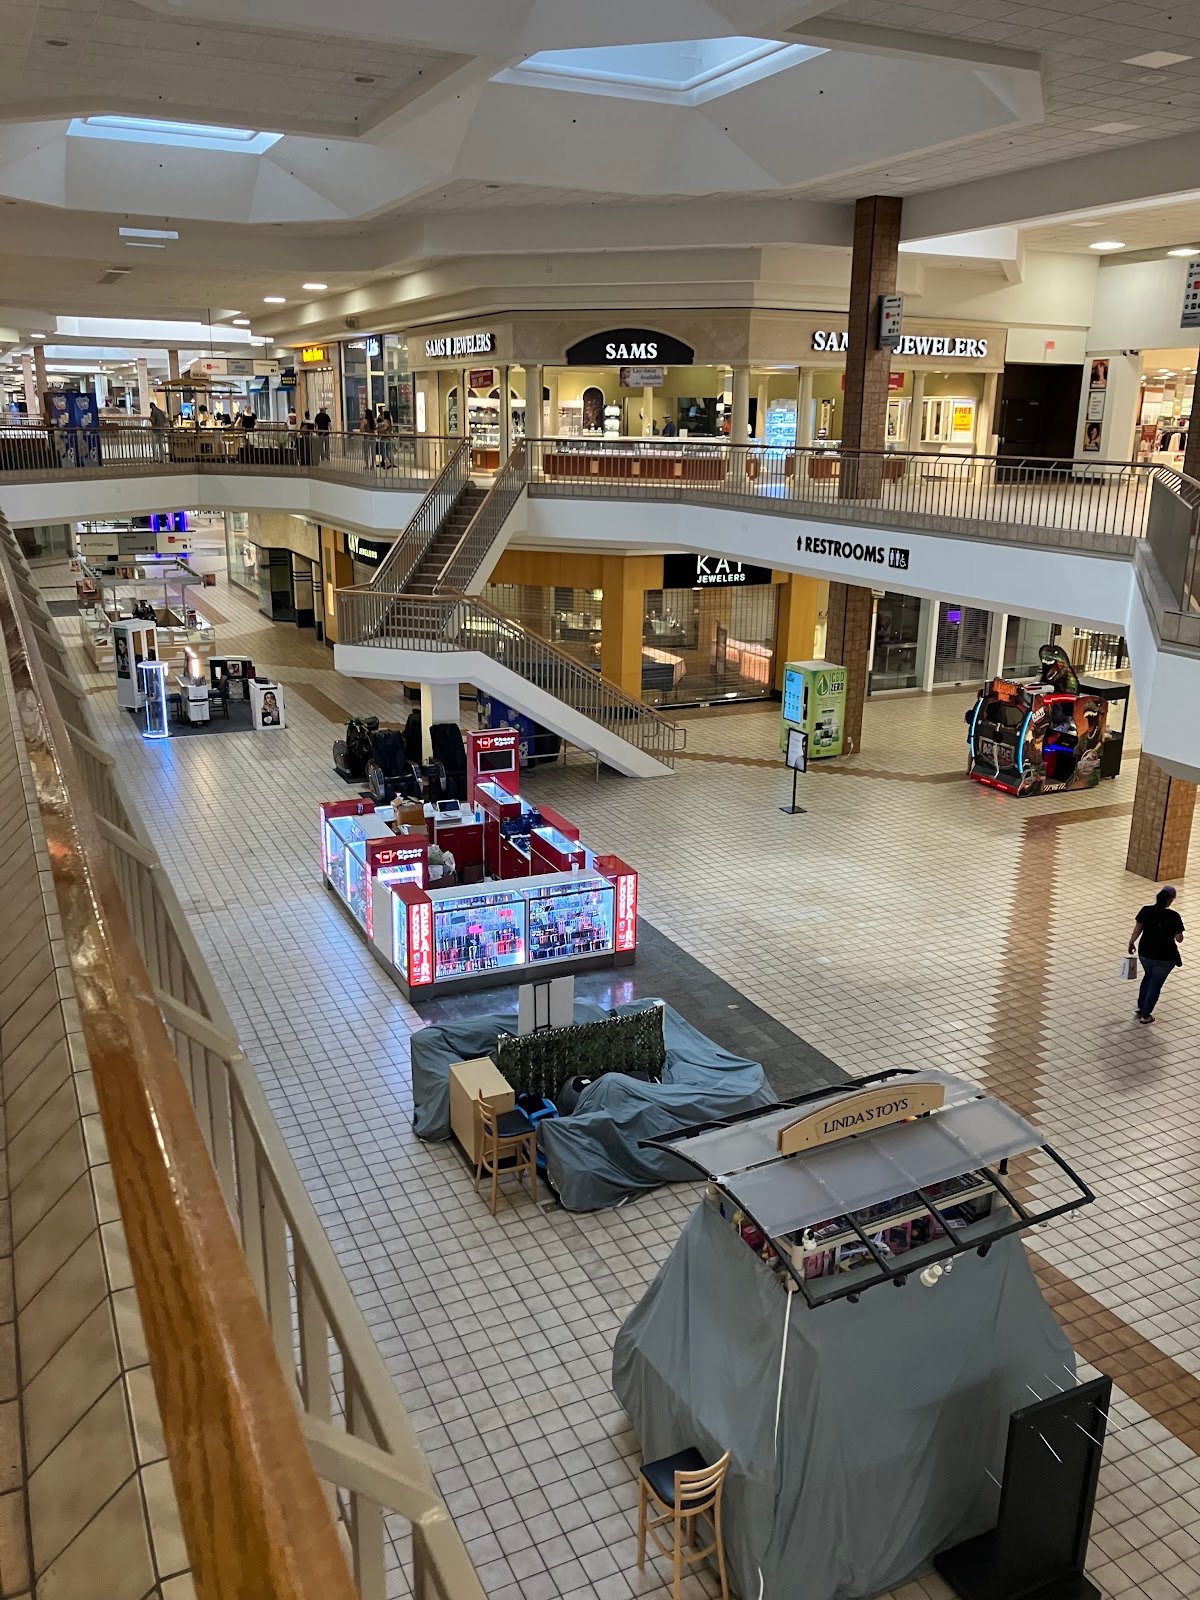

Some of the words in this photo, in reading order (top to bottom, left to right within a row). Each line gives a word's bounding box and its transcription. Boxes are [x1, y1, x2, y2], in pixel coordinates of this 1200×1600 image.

[425, 340, 446, 357] SAMS
[452, 333, 492, 355] JEWELERS
[605, 342, 658, 360] SAMS
[813, 330, 849, 352] SA
[892, 335, 988, 358] JEWELERS
[954, 407, 973, 415] FREE
[805, 536, 885, 564] RESTROOMS
[697, 573, 746, 584] JEWELERS
[830, 682, 844, 692] ZERO
[412, 904, 421, 951] PHONE
[420, 903, 431, 977] REPAIR
[823, 1108, 874, 1134] LINDA'S
[875, 1098, 908, 1118] TOYS
